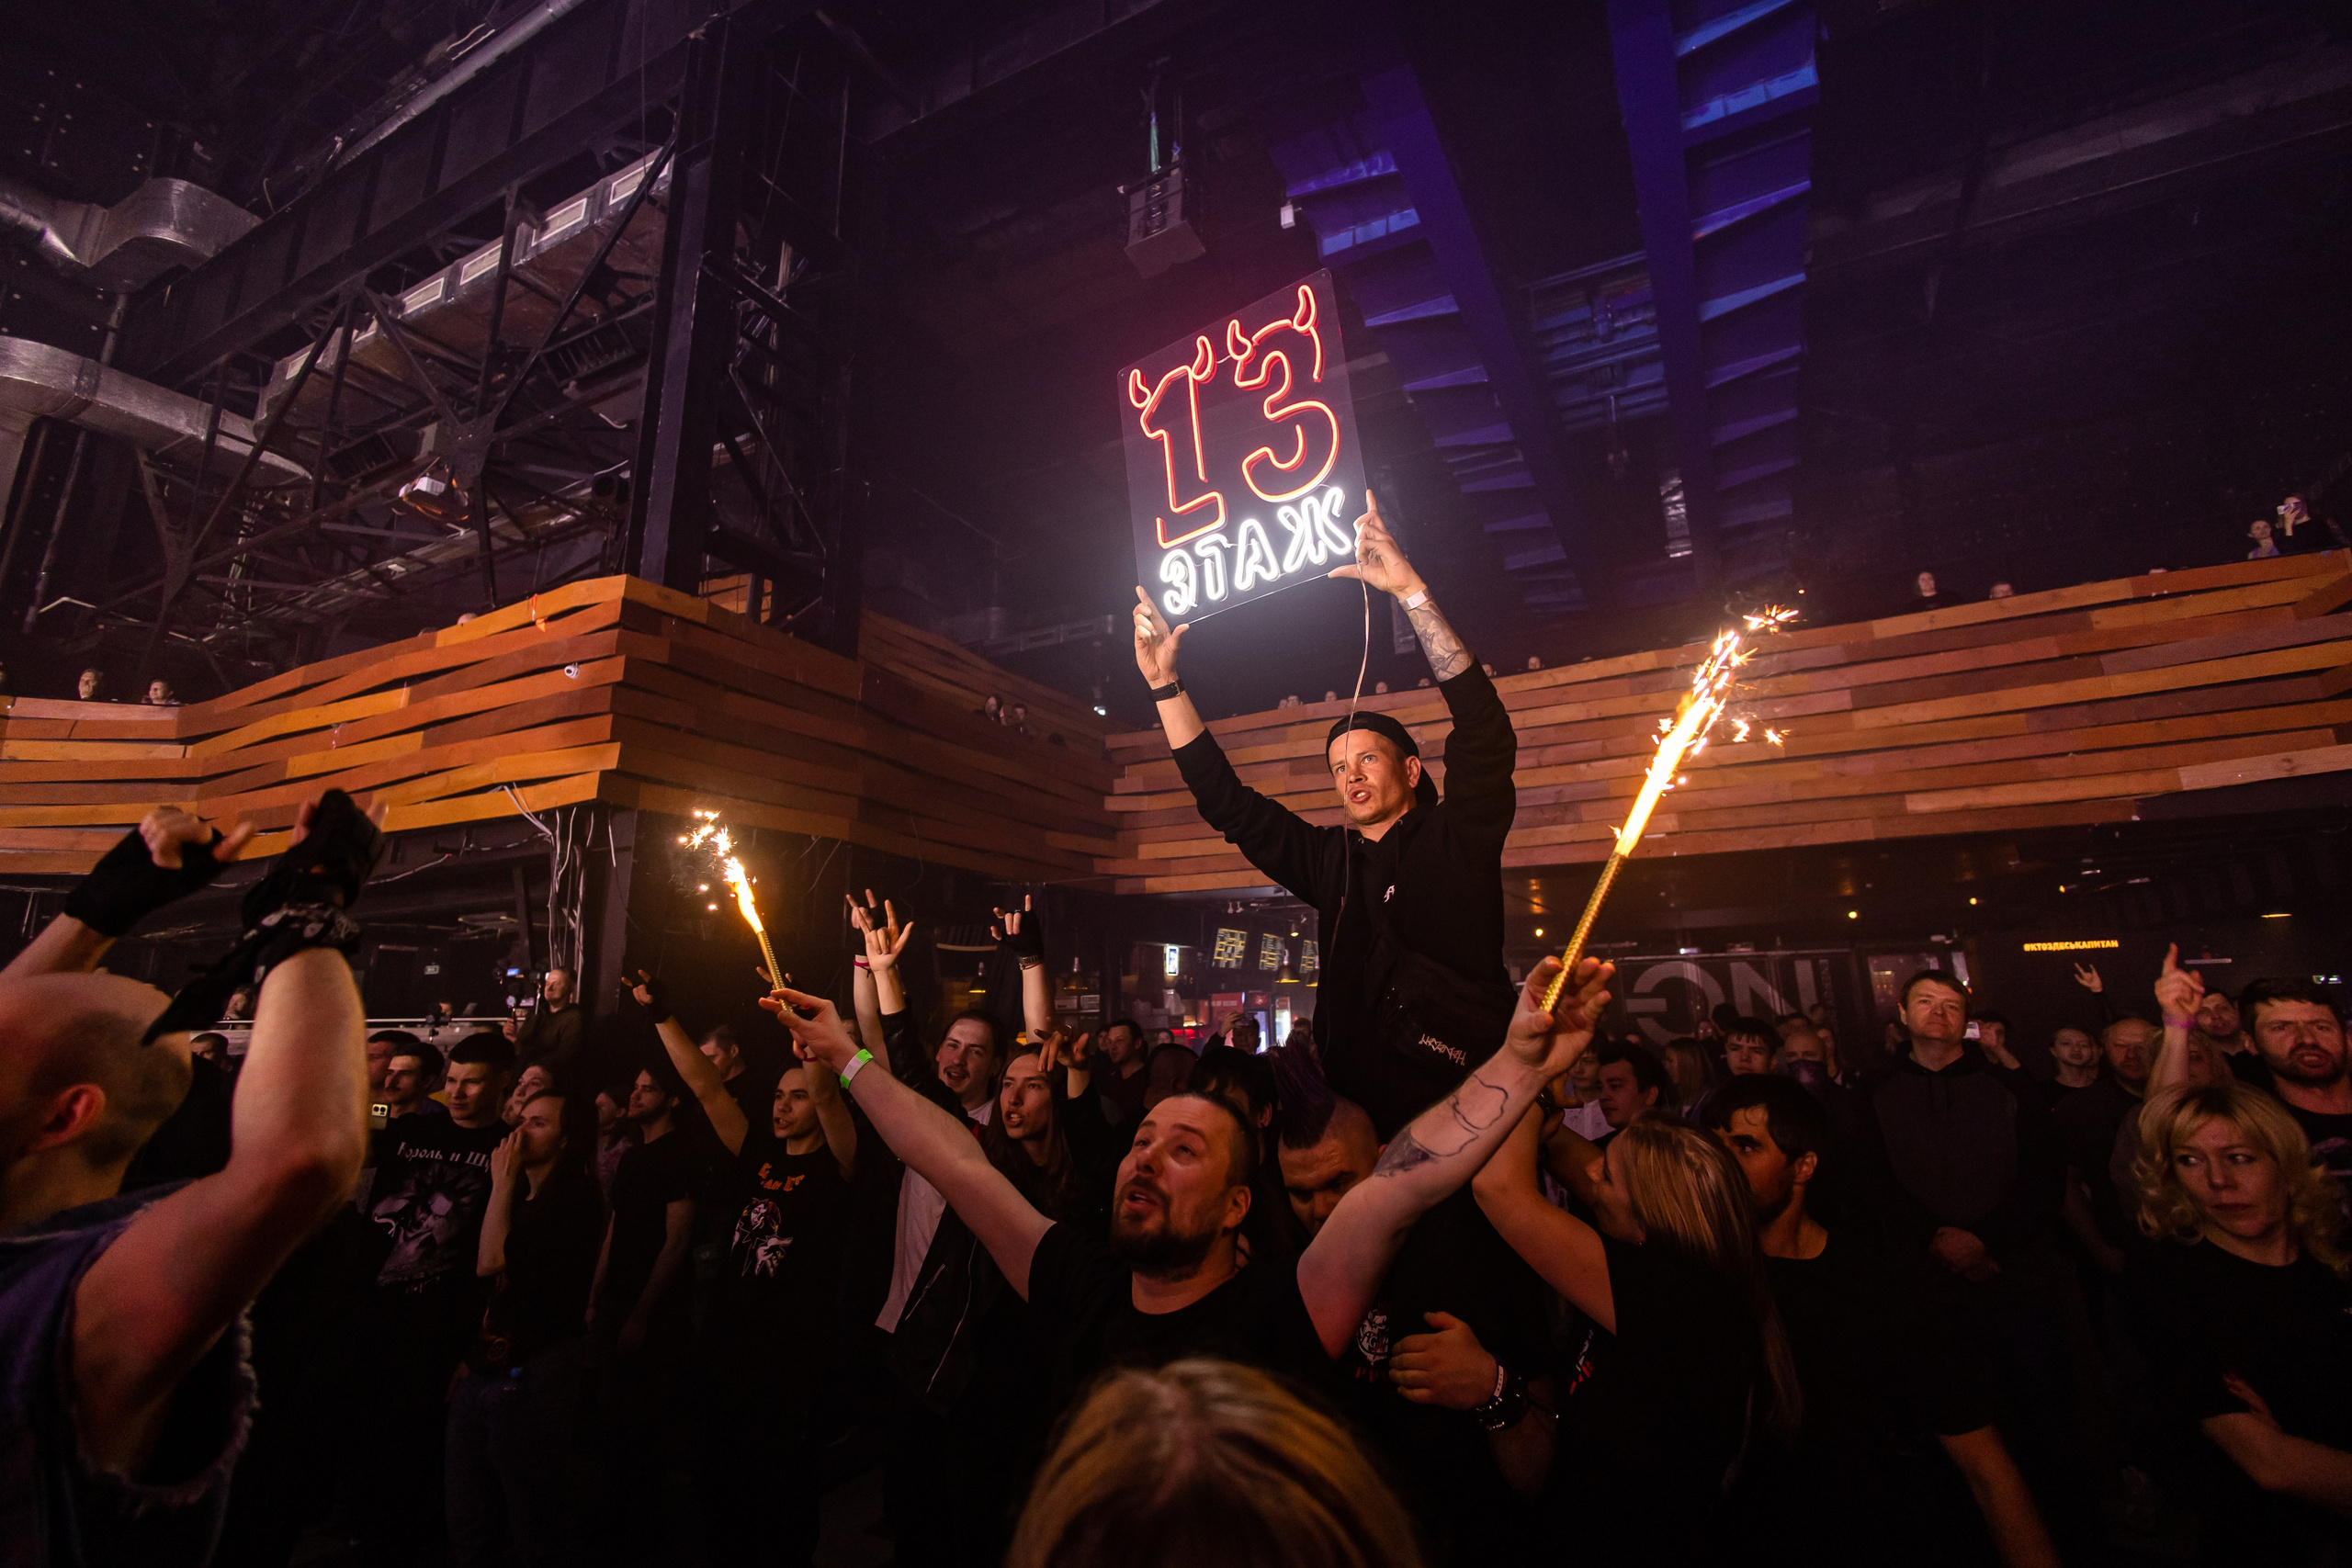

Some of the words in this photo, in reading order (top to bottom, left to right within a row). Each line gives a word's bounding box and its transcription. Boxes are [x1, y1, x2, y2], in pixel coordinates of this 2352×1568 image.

[1129, 285, 1340, 549] 13
[1159, 486, 1353, 615] ЭТАЖ
[464, 1150, 491, 1173] Шу
